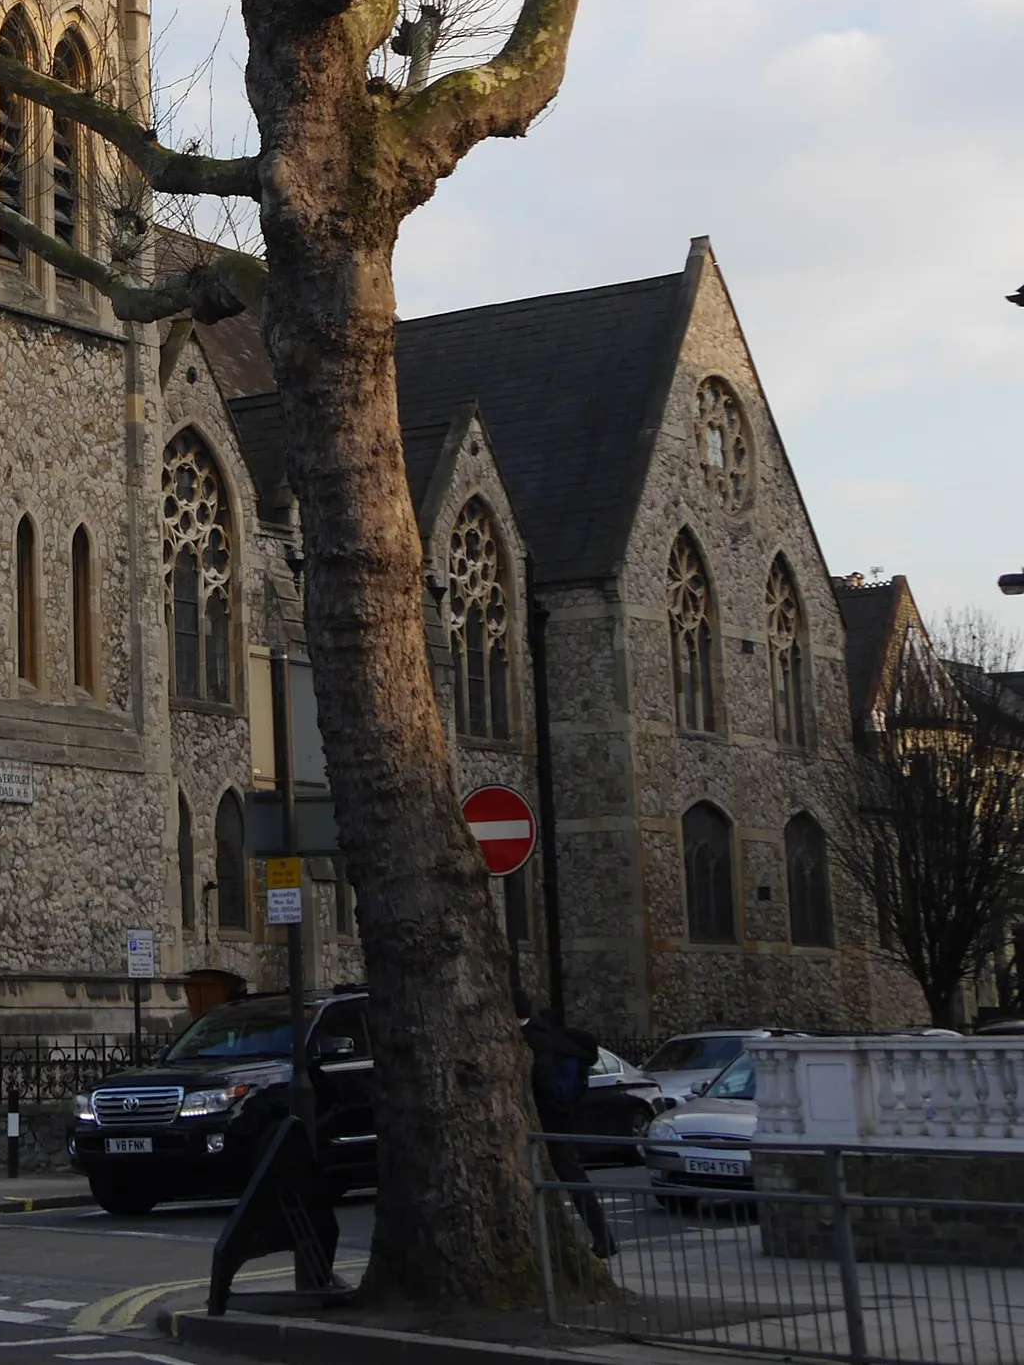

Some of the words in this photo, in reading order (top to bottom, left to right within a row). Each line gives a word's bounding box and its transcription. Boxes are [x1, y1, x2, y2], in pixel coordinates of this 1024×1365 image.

[129, 1140, 145, 1151] FNK
[690, 1160, 716, 1173] EY04
[719, 1162, 739, 1174] TYS
